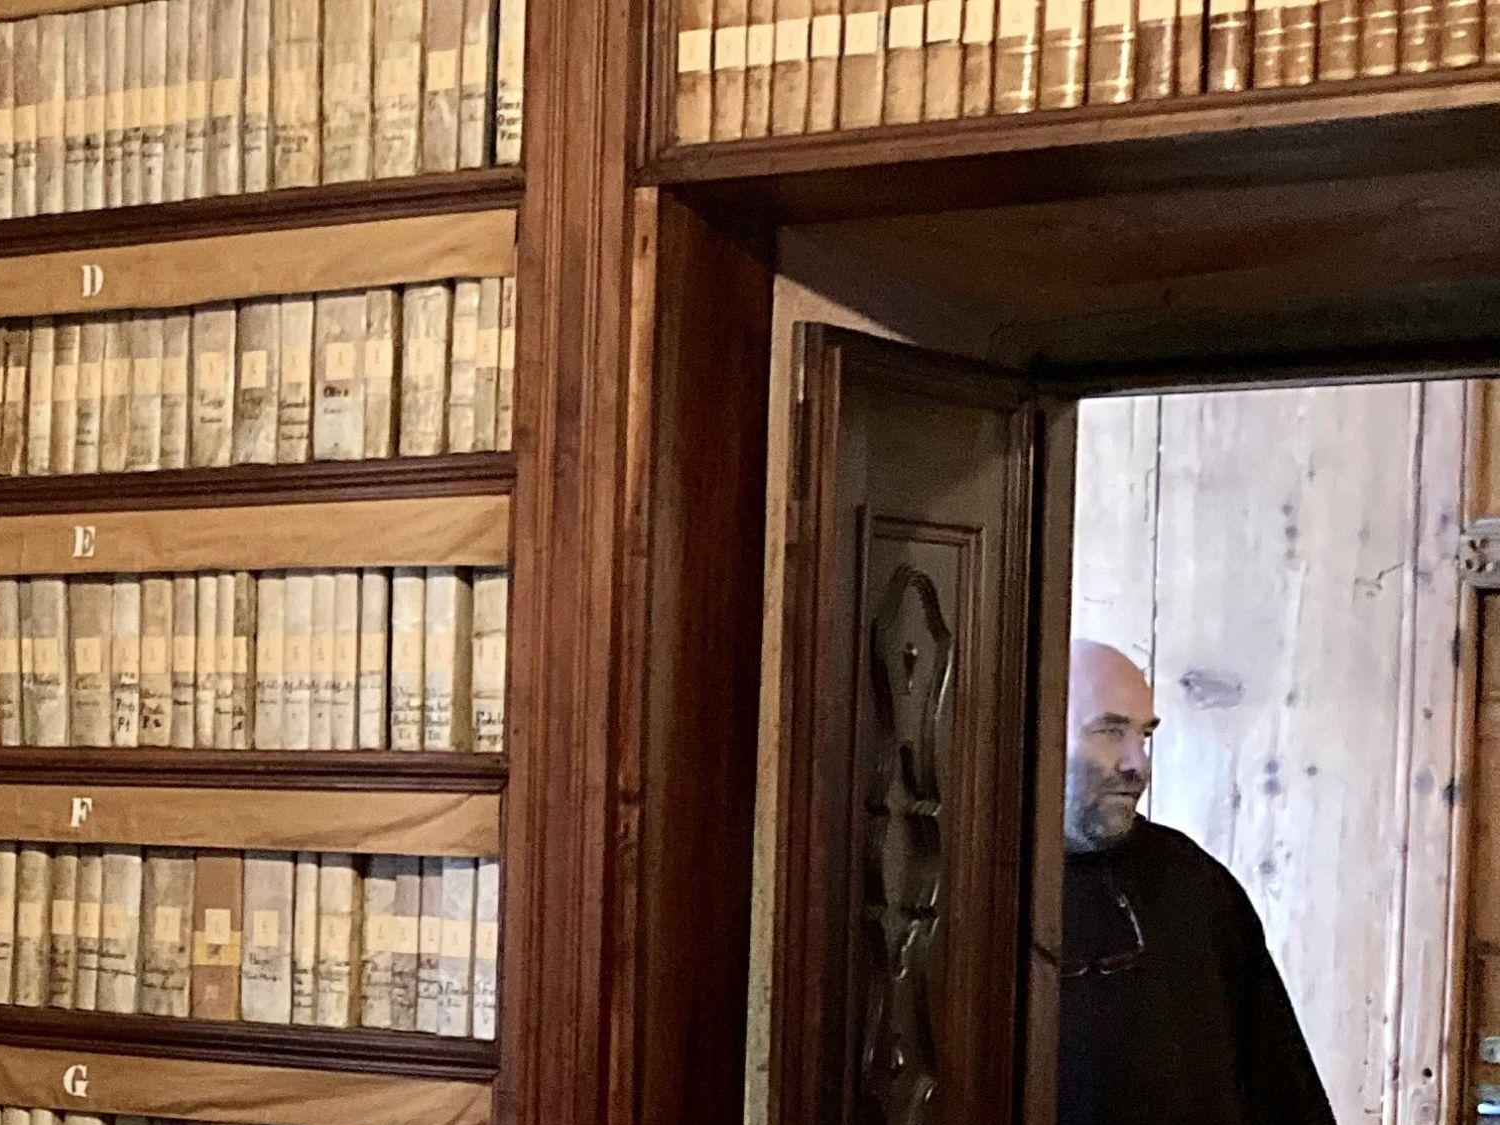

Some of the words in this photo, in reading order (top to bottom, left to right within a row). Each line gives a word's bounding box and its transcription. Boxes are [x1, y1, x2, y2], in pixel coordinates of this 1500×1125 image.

[81, 265, 103, 297] D
[72, 525, 95, 557] E
[70, 797, 93, 828] F
[63, 1064, 88, 1098] G
